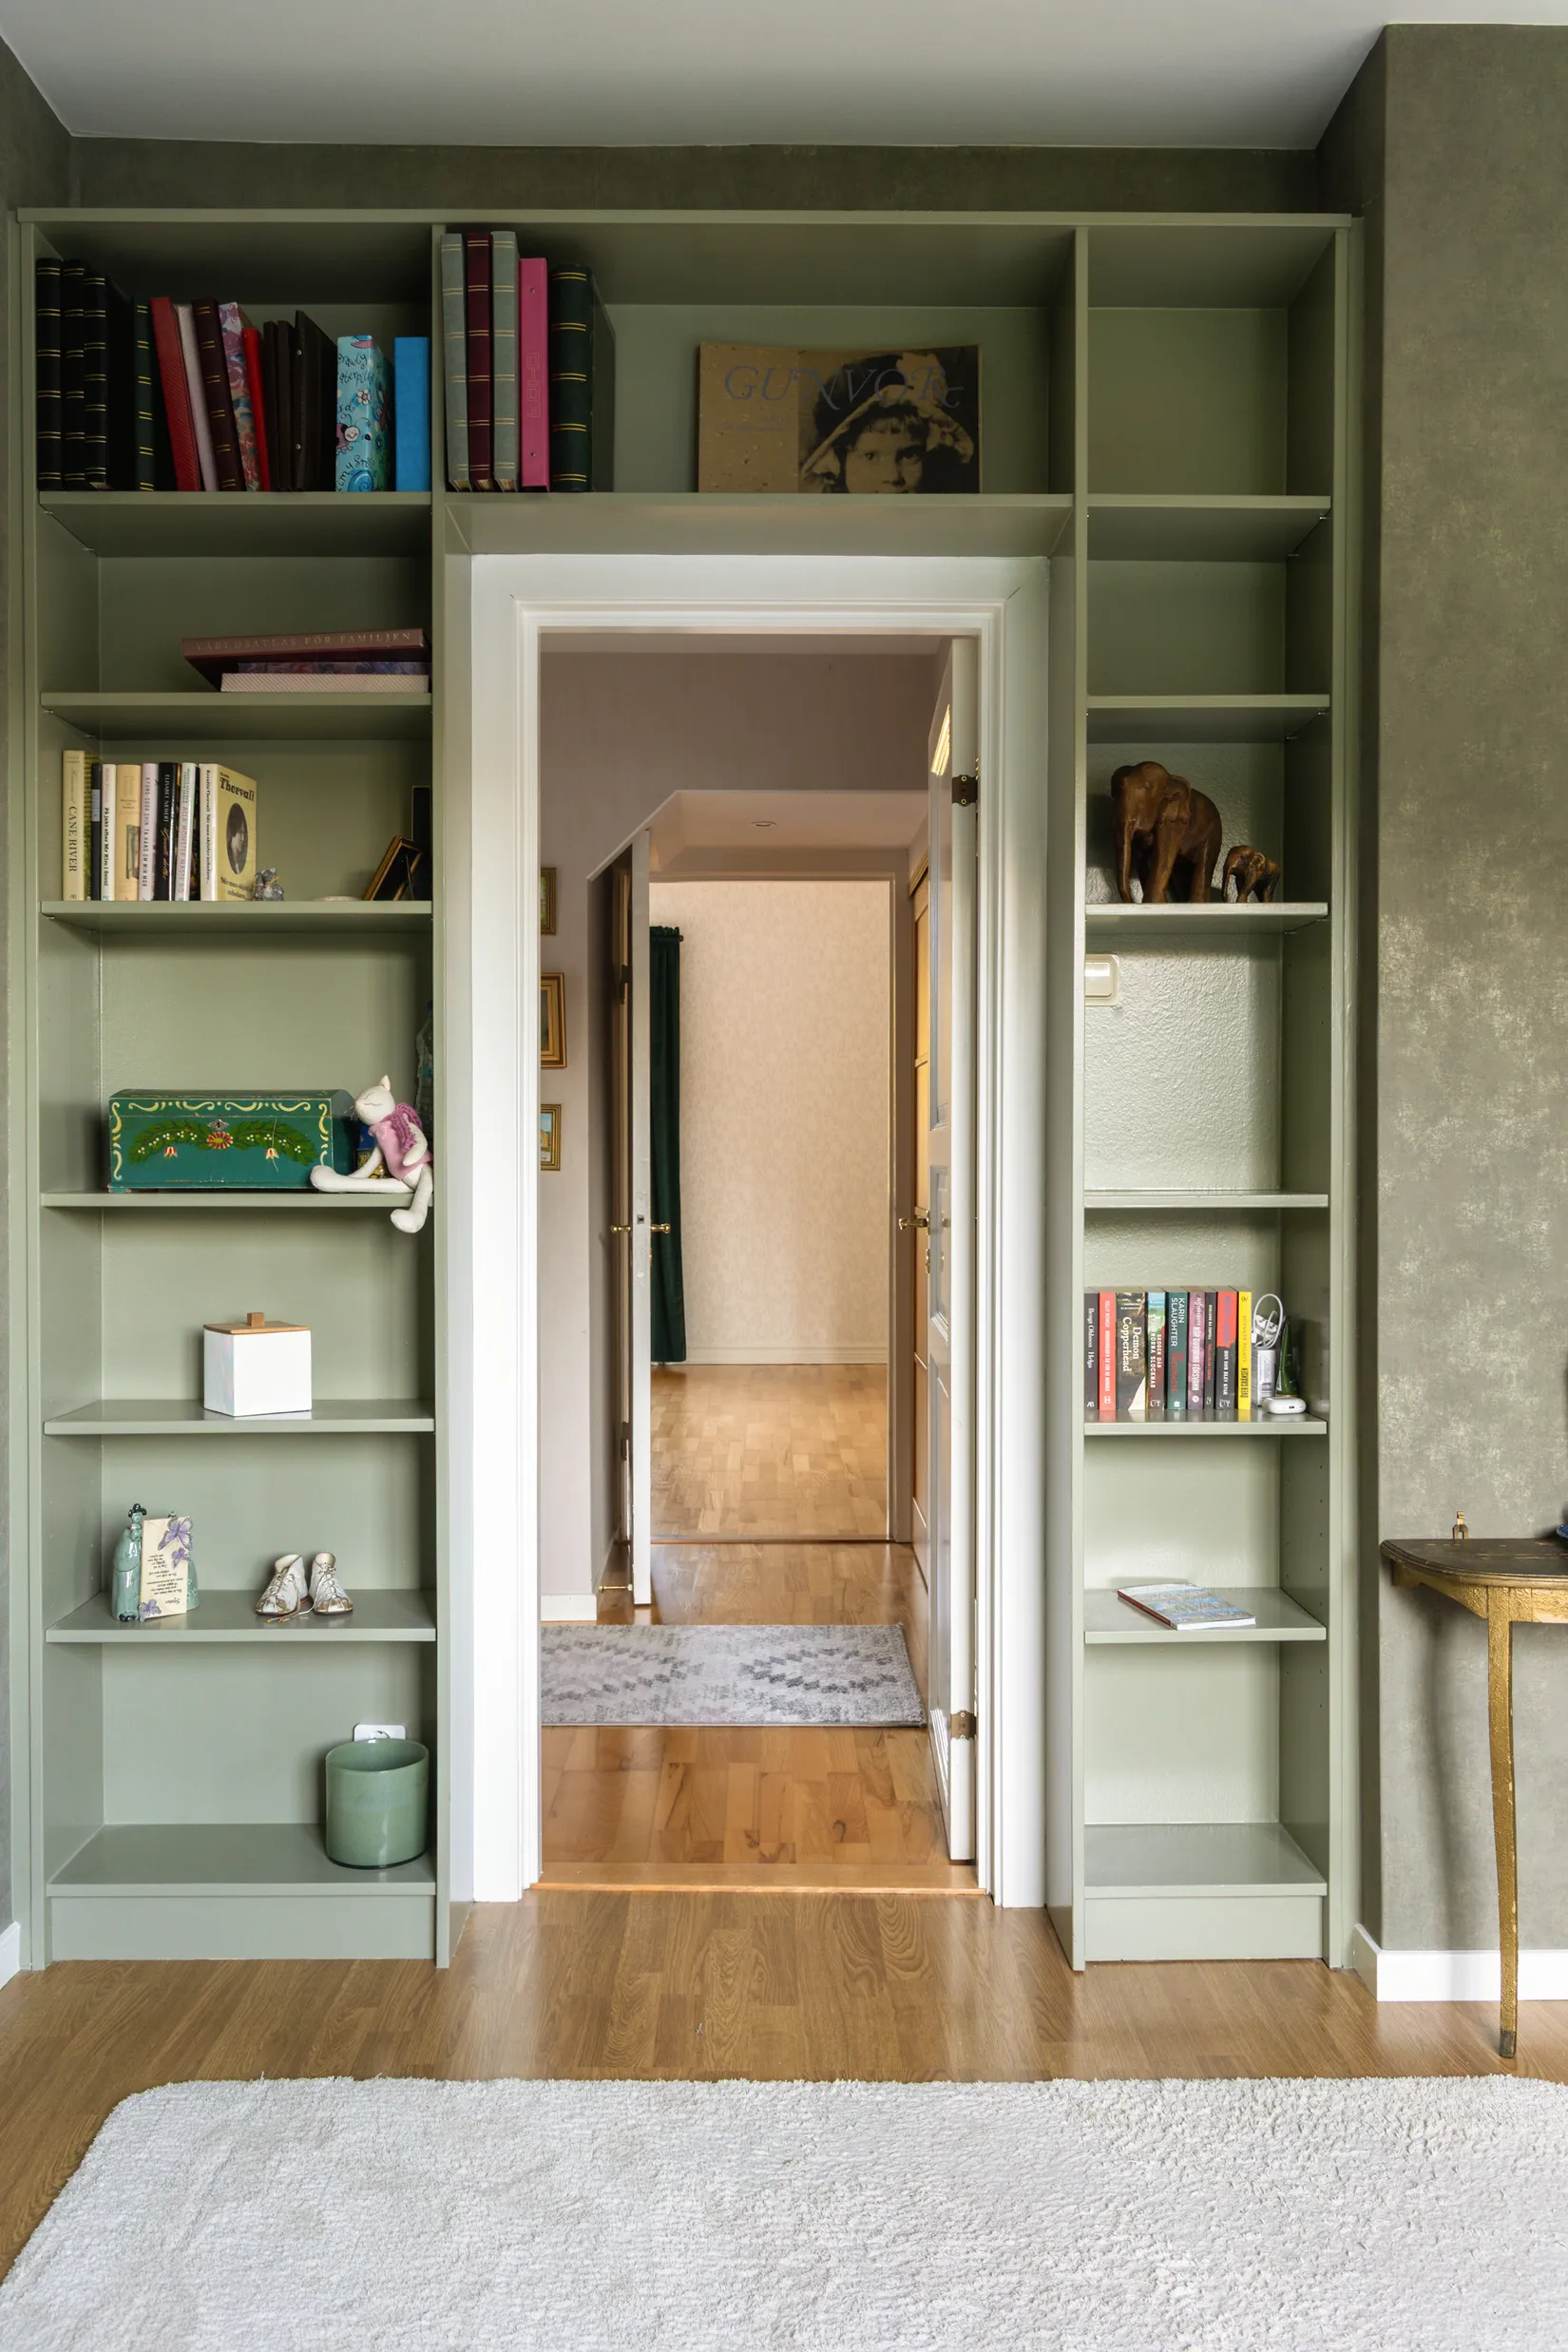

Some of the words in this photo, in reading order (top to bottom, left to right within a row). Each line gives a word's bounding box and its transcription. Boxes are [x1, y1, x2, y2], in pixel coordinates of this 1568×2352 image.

[304, 634, 333, 645] FÖR
[339, 631, 412, 646] FAMILJEN
[220, 776, 255, 802] Thorvall
[104, 807, 110, 815] På
[68, 806, 78, 836] CANE
[68, 839, 78, 872] RIVER
[104, 844, 109, 853] Mr
[143, 853, 149, 862] OM
[1086, 1307, 1095, 1325] Bengt
[1120, 1316, 1132, 1372] Copperhead
[1133, 1326, 1142, 1360] Demon
[1086, 1351, 1095, 1368] Helga
